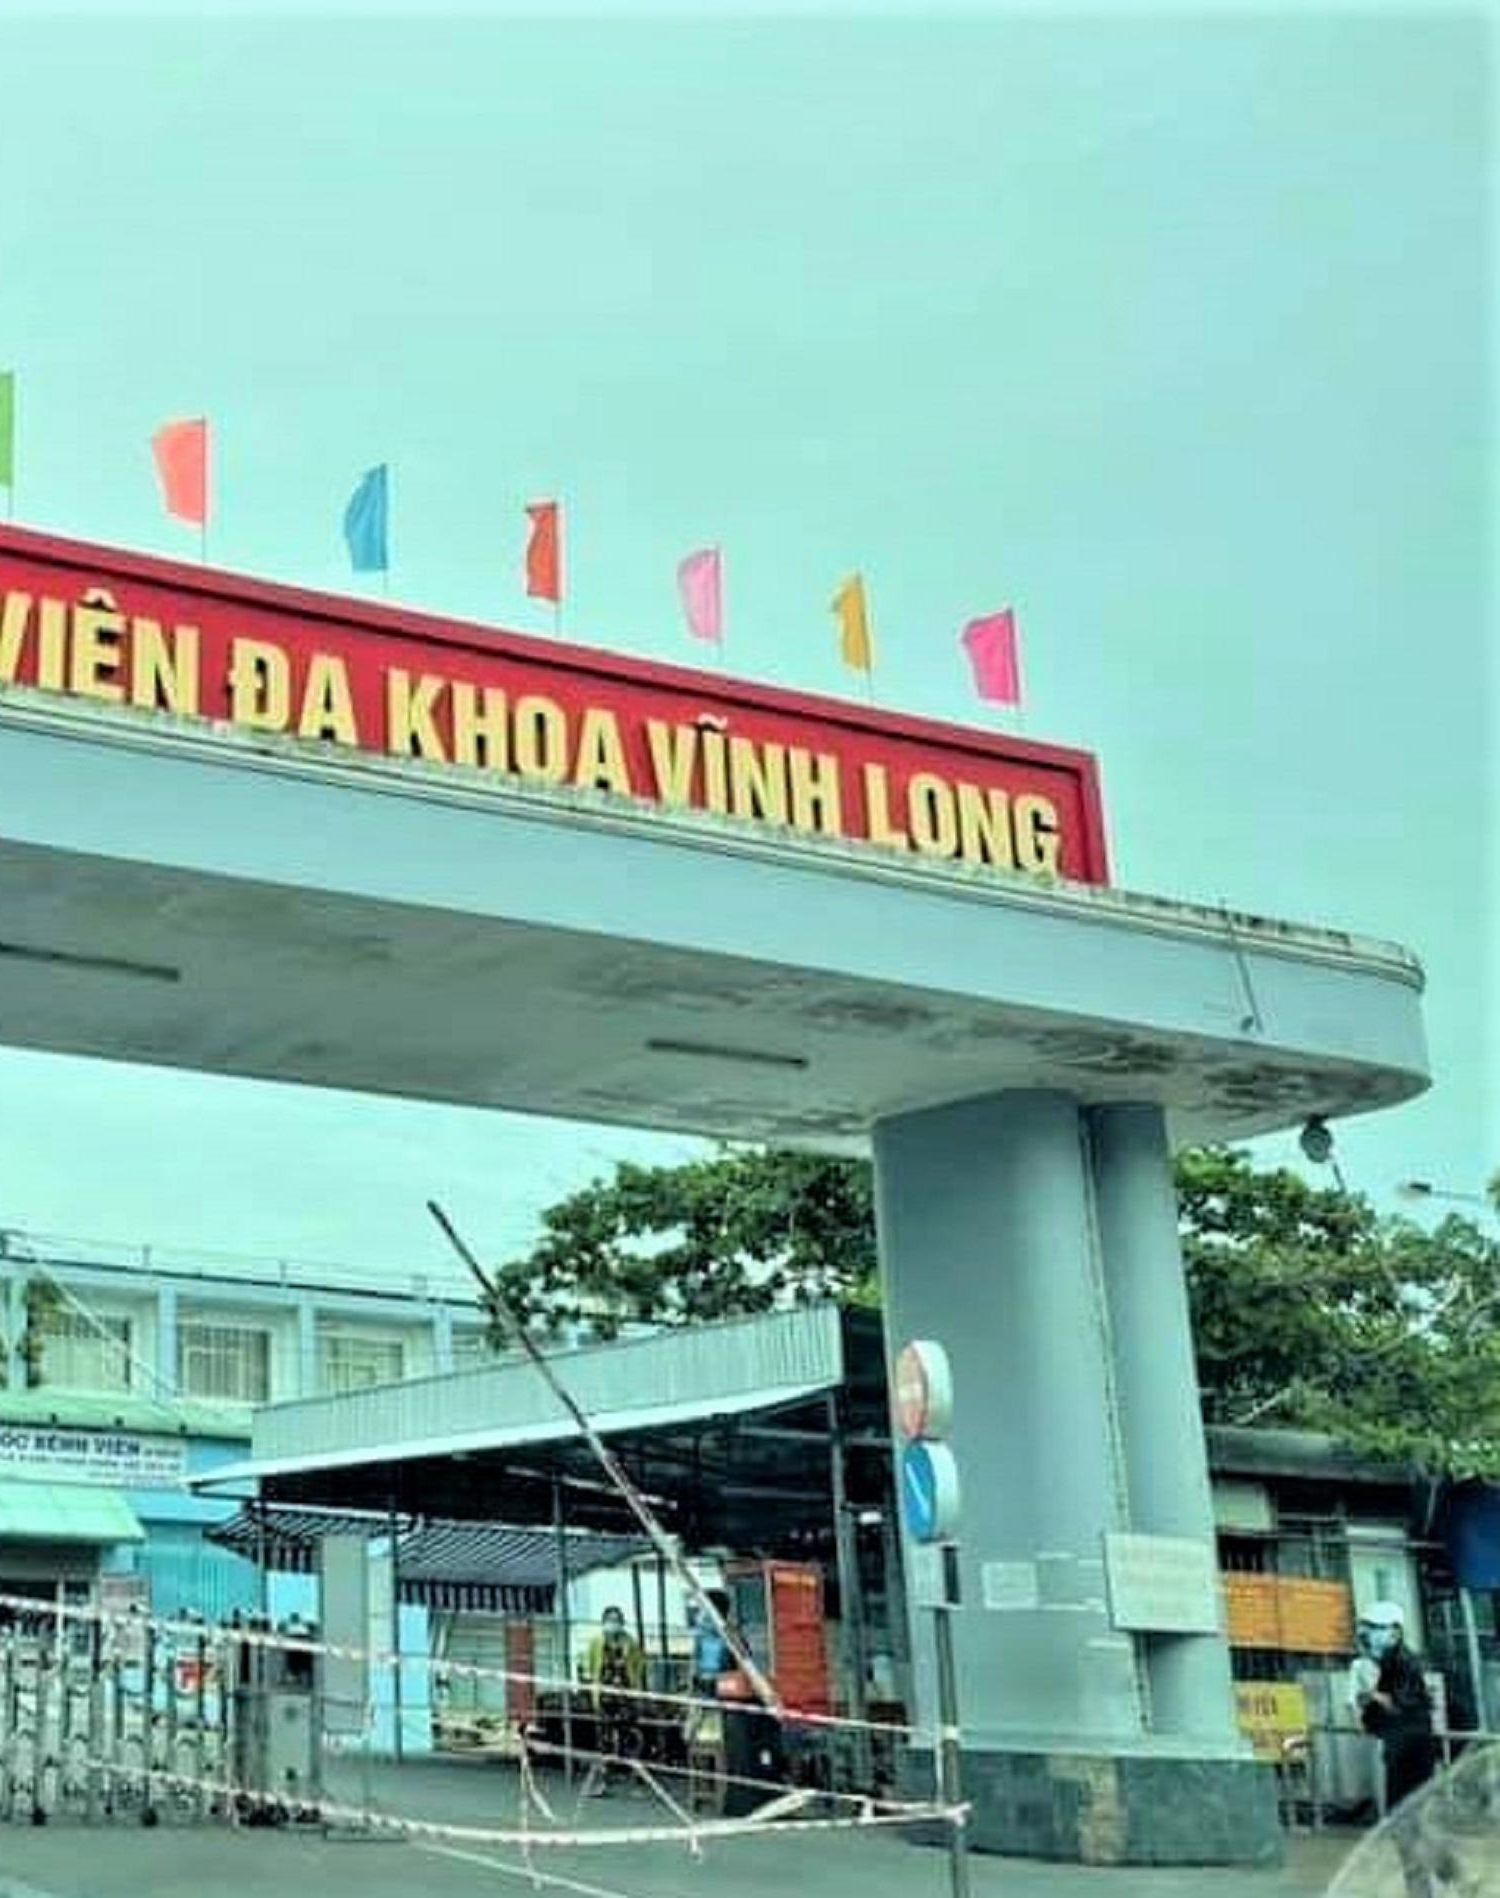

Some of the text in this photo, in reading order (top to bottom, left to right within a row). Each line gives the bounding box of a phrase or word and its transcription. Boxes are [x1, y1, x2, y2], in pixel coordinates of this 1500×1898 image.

[230, 638, 358, 744] ĐA
[386, 668, 632, 798] KHOA
[648, 715, 844, 838] VĨNH
[866, 762, 1060, 876] LONG
